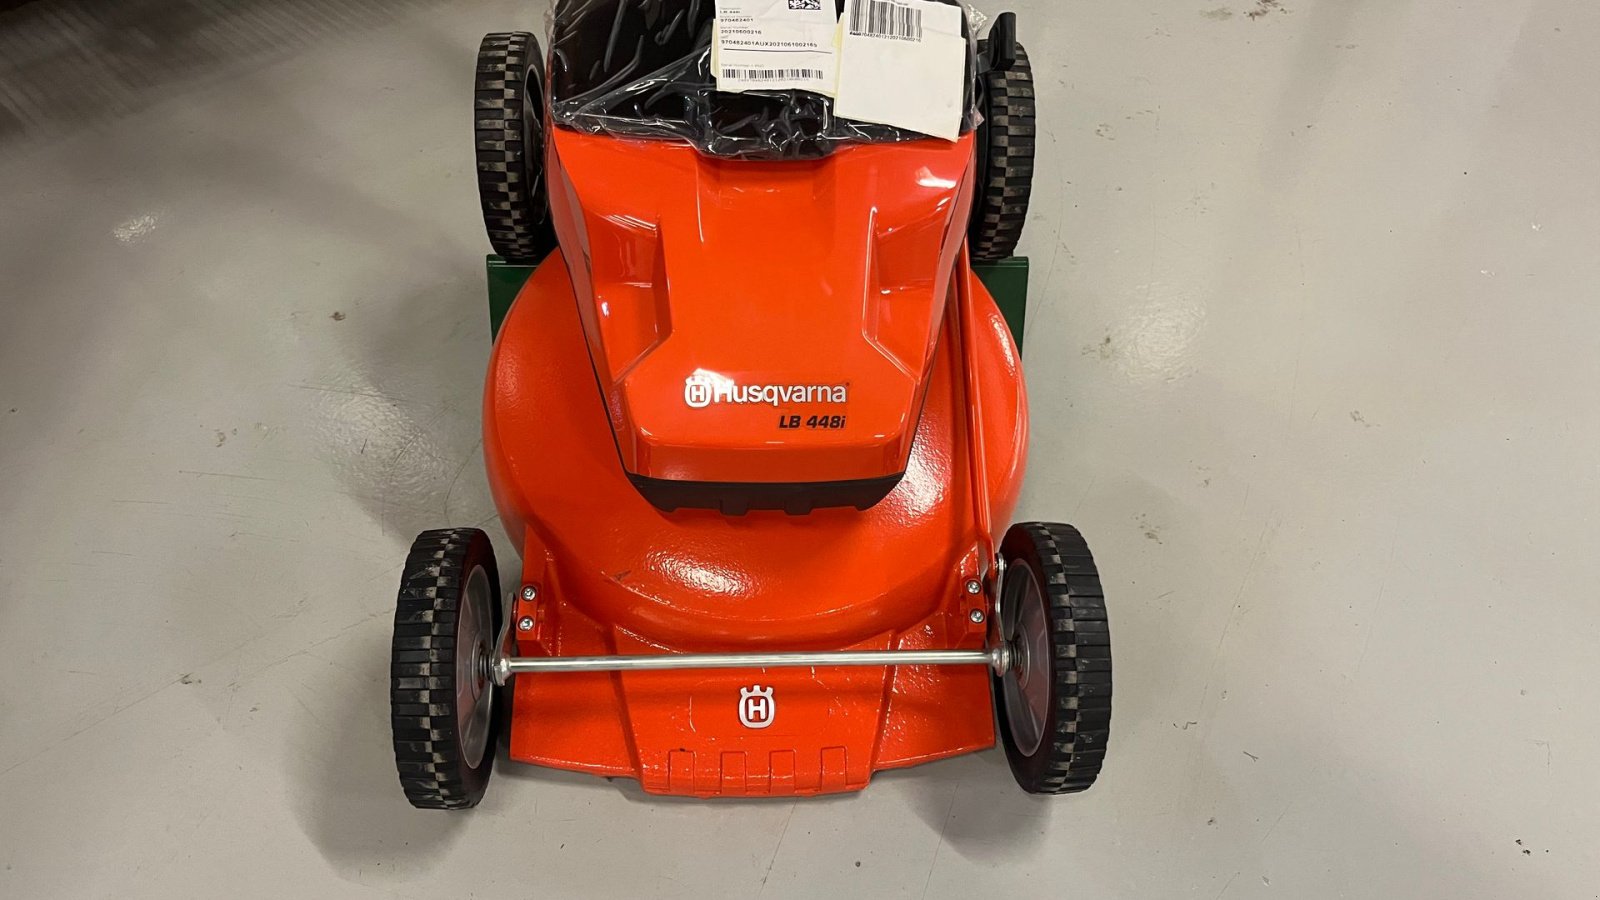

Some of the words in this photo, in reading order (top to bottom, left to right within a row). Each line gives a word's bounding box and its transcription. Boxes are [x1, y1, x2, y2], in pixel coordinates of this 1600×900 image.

[713, 379, 847, 406] Husqvarna
[778, 415, 801, 429] LB
[806, 415, 846, 429] 448i
